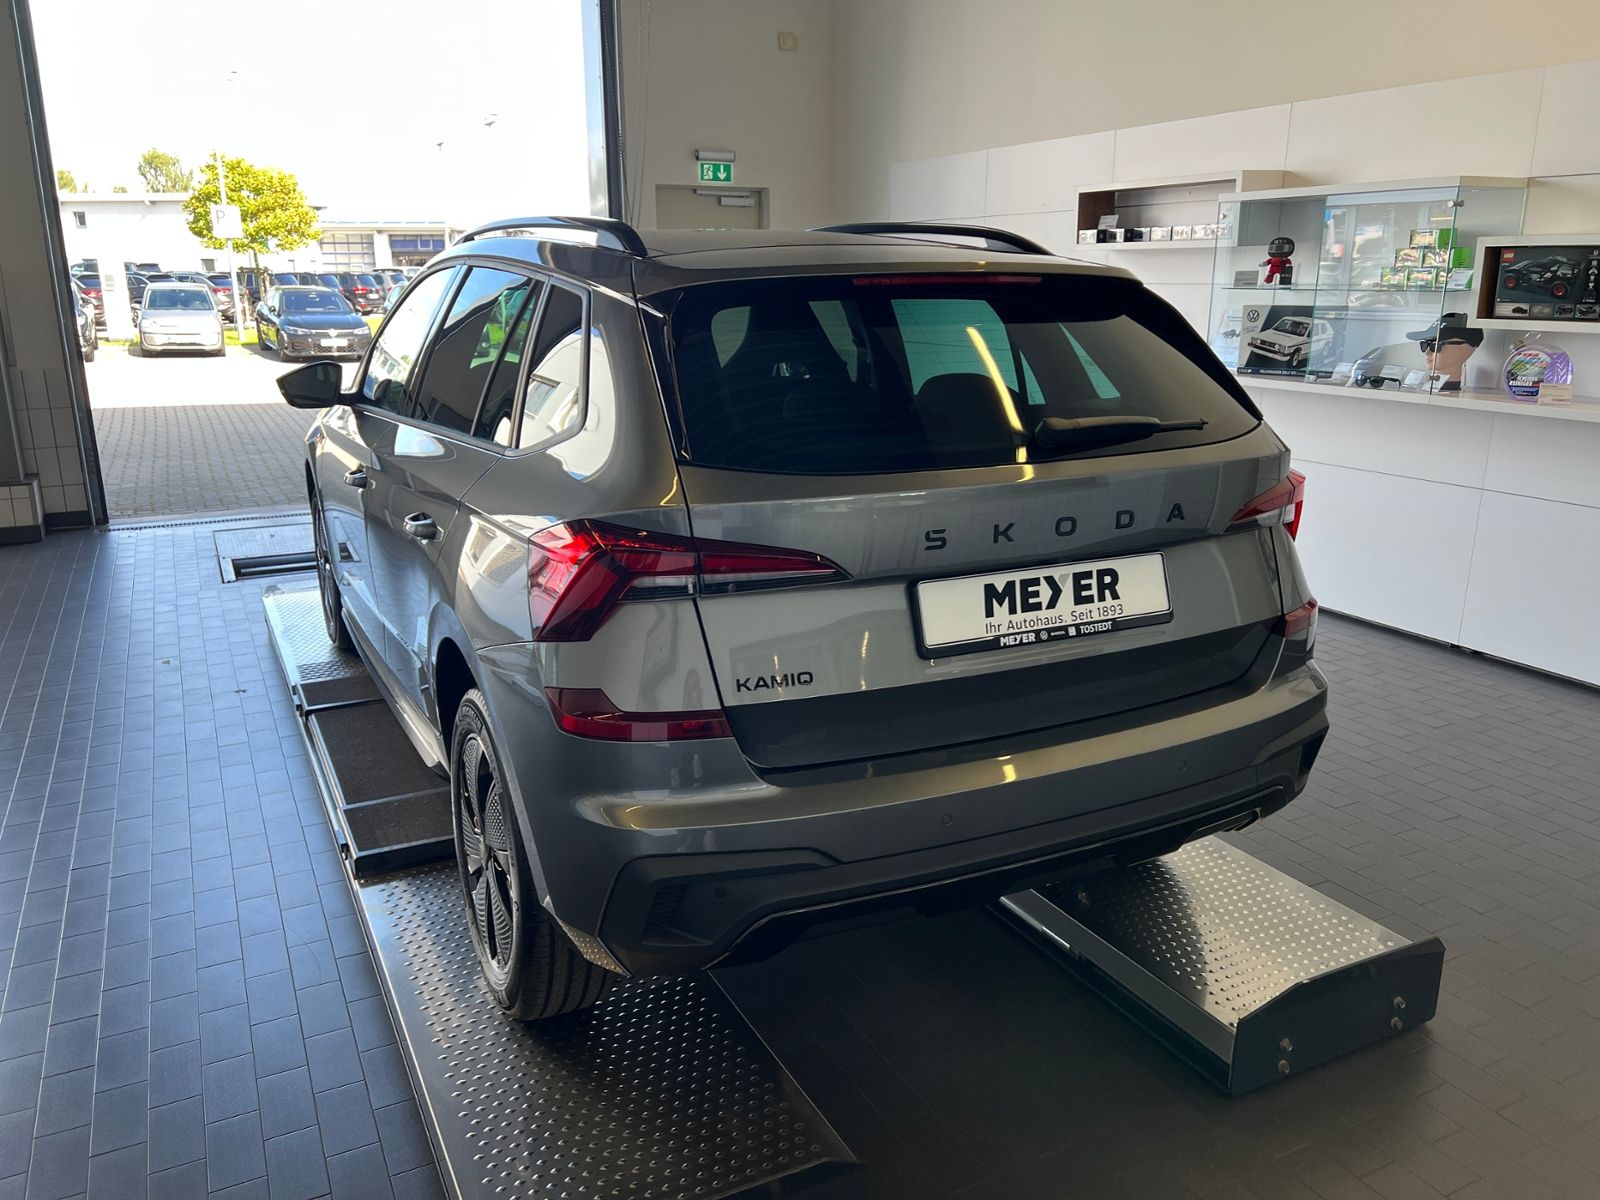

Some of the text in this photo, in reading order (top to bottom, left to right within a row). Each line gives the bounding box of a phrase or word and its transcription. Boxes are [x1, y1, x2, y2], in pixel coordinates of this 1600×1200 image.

[216, 210, 225, 224] P
[984, 567, 1121, 619] MEYER
[985, 604, 1124, 634] Ihr Autohaus. Seit 1893
[1000, 632, 1036, 646] MEYER
[1079, 621, 1113, 634] TOSTEDT
[736, 671, 814, 692] KAMIQ
